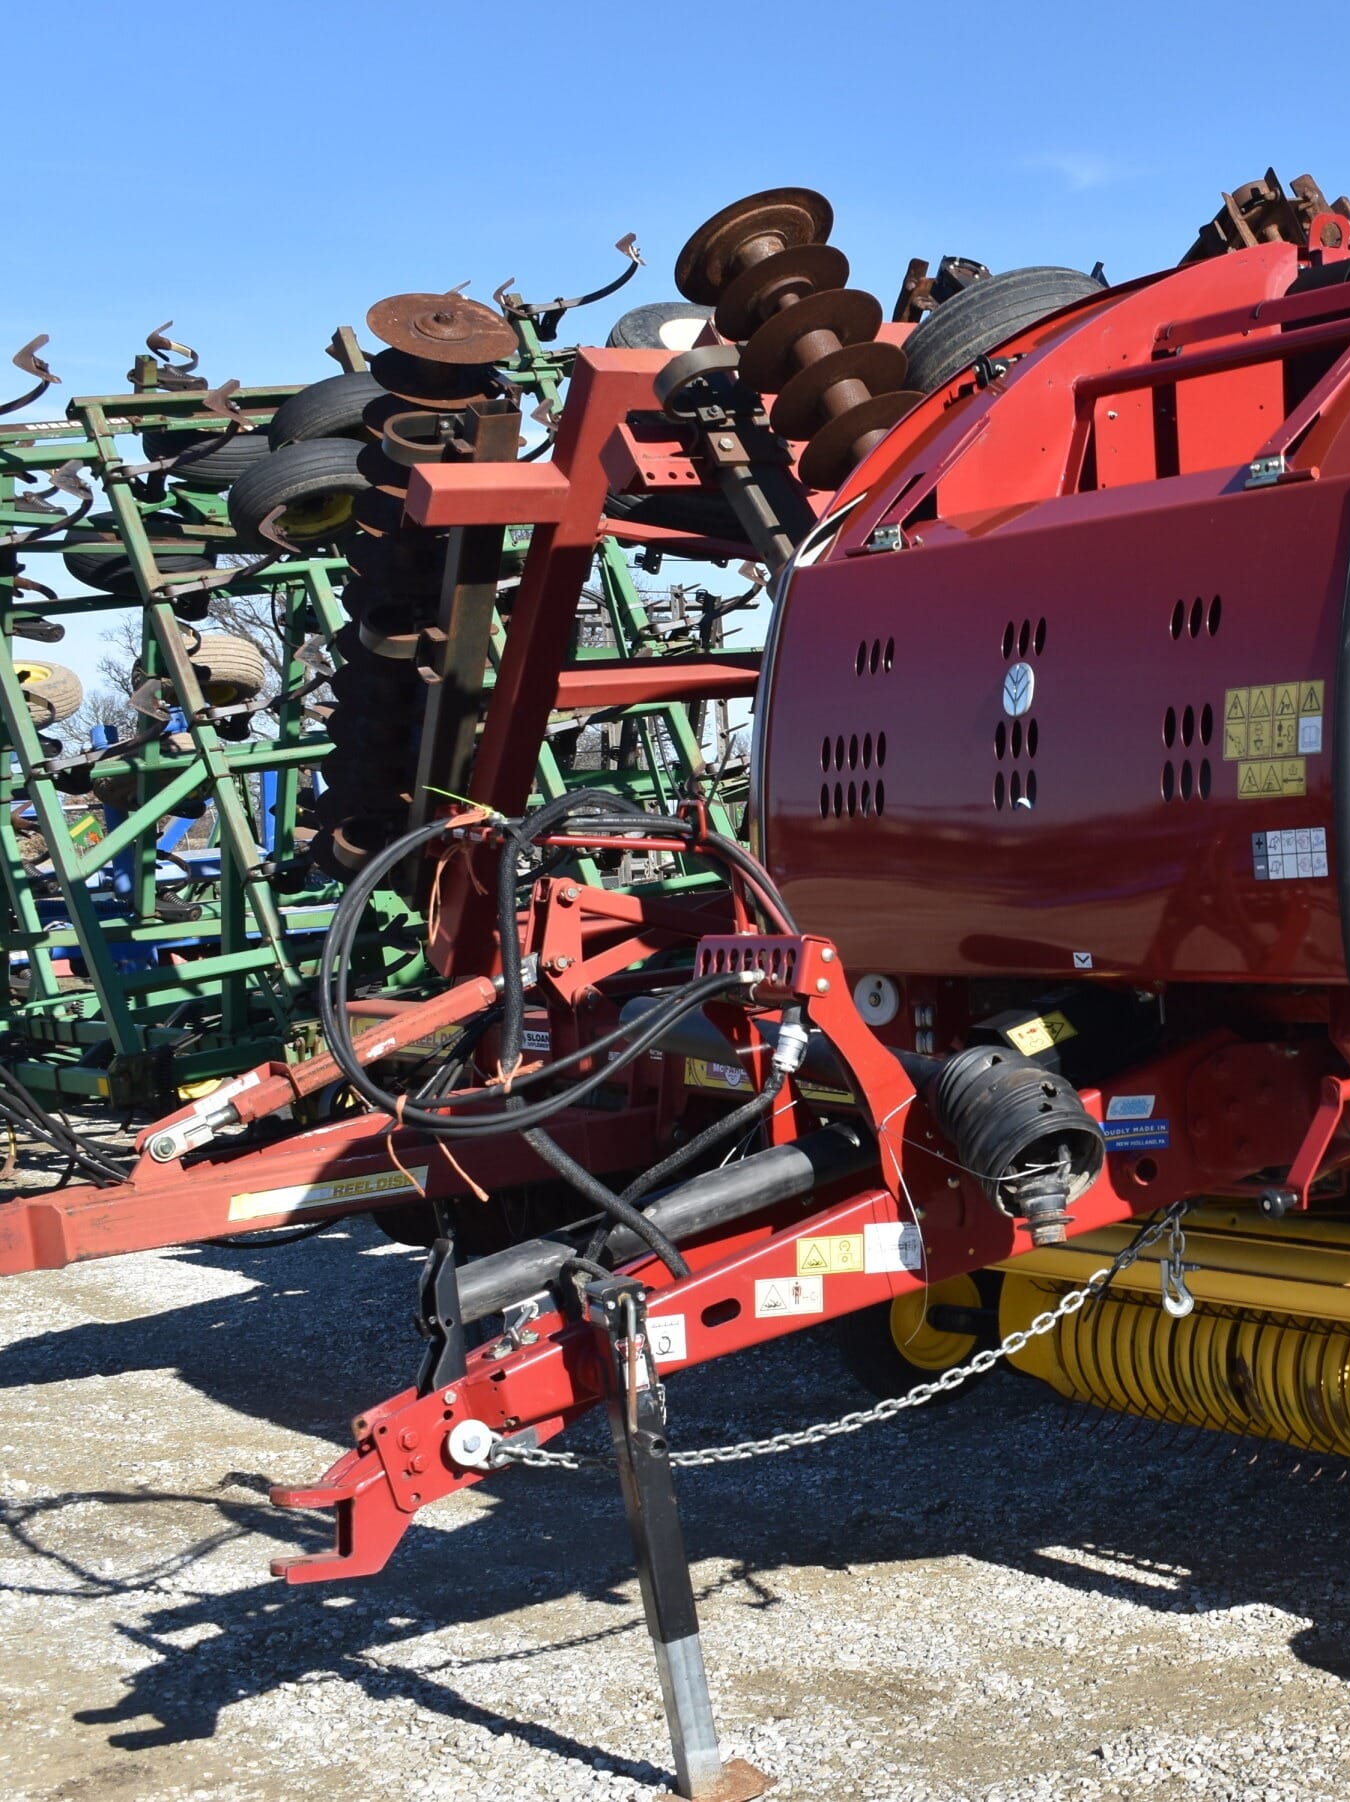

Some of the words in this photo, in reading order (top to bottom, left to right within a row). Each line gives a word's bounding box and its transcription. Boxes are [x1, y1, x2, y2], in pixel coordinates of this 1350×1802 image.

[1104, 1127, 1130, 1137] OUDLY
[1133, 1125, 1154, 1133] MADE
[333, 1180, 376, 1197] REEL
